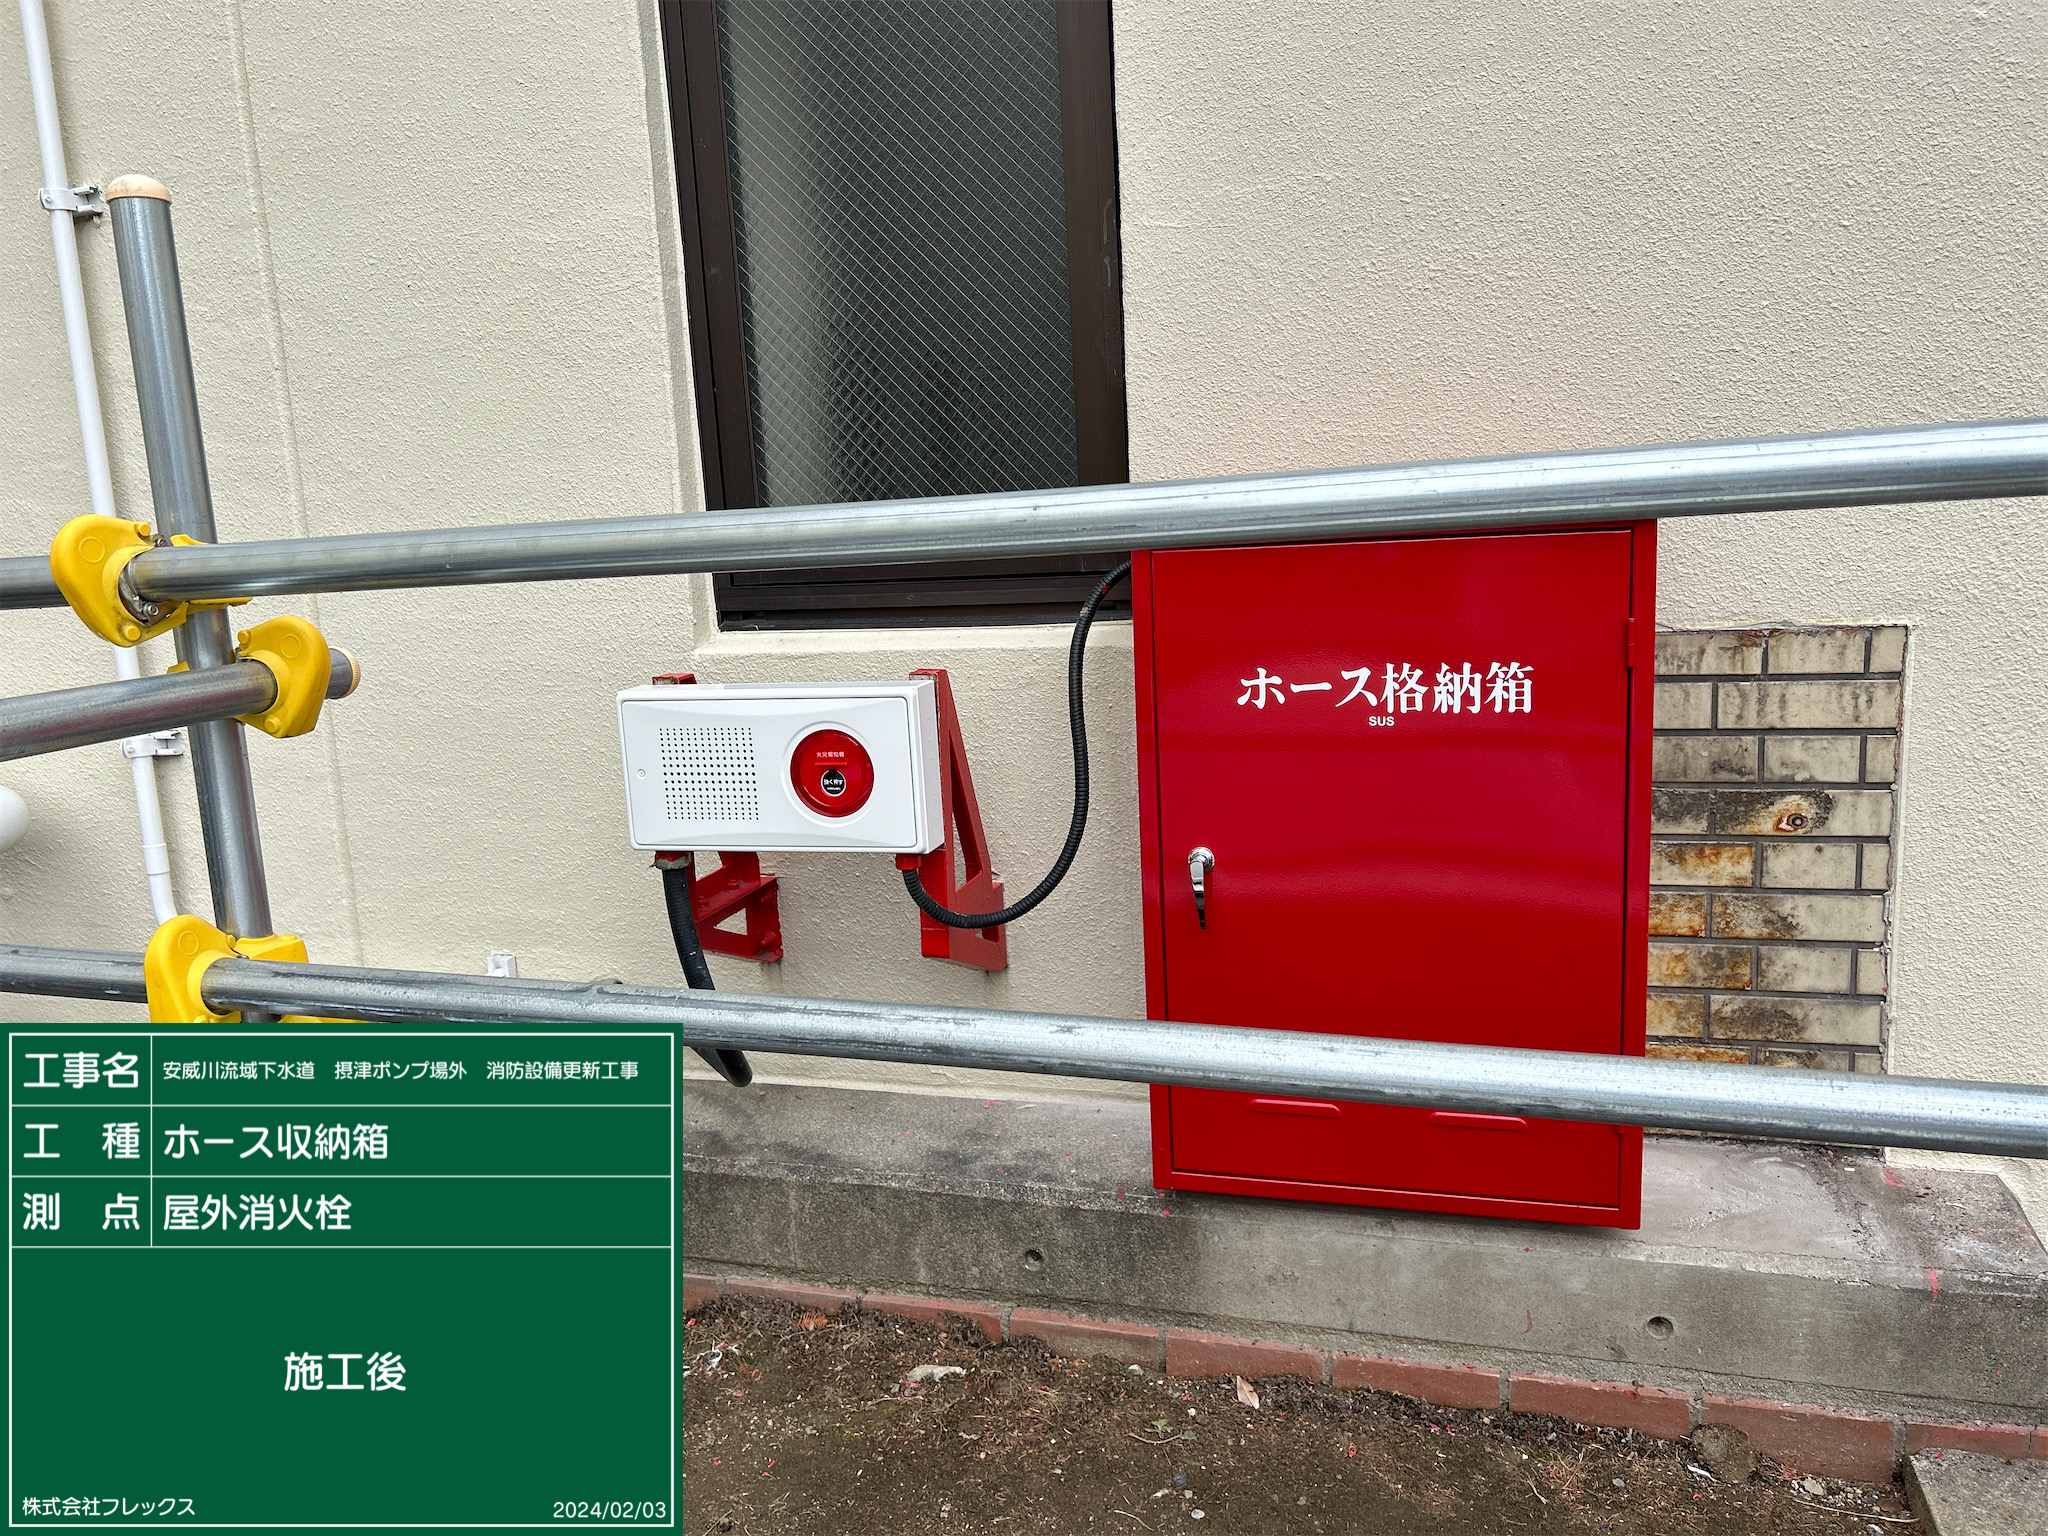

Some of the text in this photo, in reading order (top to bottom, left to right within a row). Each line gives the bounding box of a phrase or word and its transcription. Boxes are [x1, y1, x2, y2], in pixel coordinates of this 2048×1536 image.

[1236, 661, 1535, 715] ホース格納箱
[1368, 715, 1395, 727] SUS
